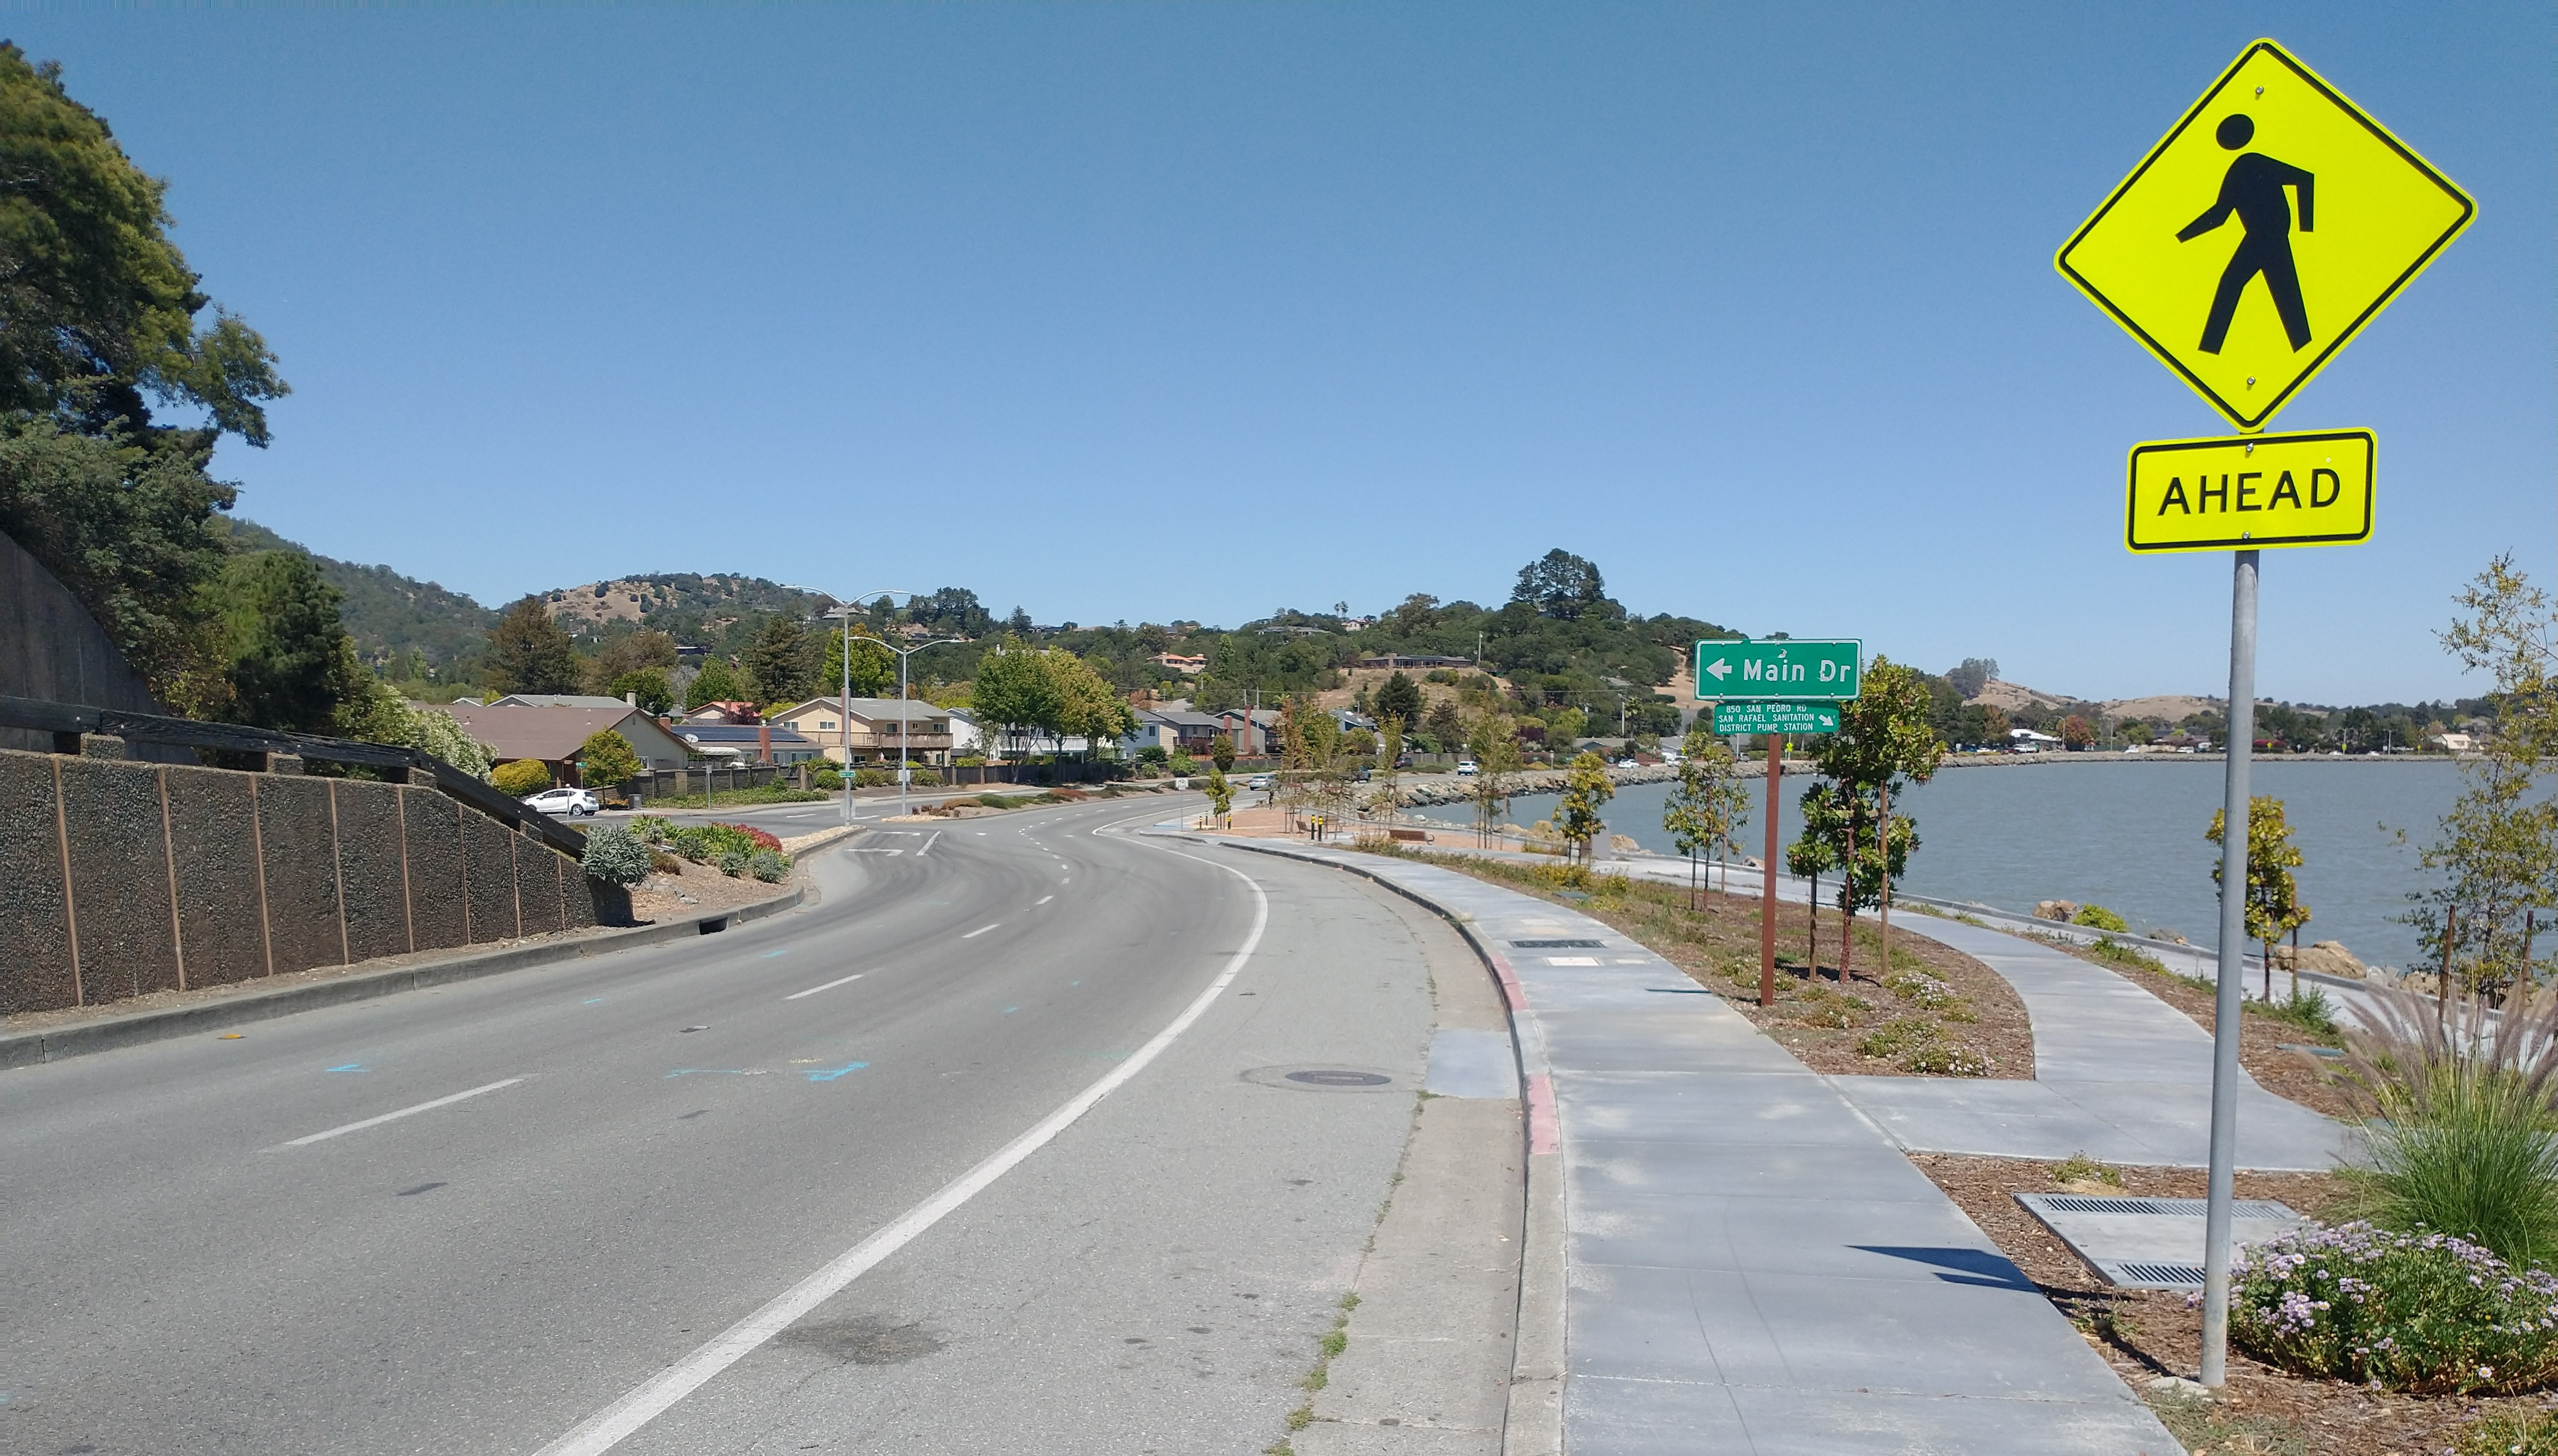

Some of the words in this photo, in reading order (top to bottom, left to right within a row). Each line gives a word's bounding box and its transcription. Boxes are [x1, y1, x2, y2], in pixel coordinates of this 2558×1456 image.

[2157, 468, 2341, 516] AHEAD
[1743, 658, 1804, 682] Main
[1819, 659, 1851, 682] Dr
[1726, 705, 1741, 713] 850
[1746, 704, 1761, 713] SAN
[1766, 704, 1791, 713] PEDRO
[1796, 704, 1807, 712] RD
[1739, 714, 1766, 722] RAFAEL
[1773, 713, 1814, 722] SANITATION
[1757, 723, 1778, 732] PUMP
[1784, 723, 1813, 731] STATION
